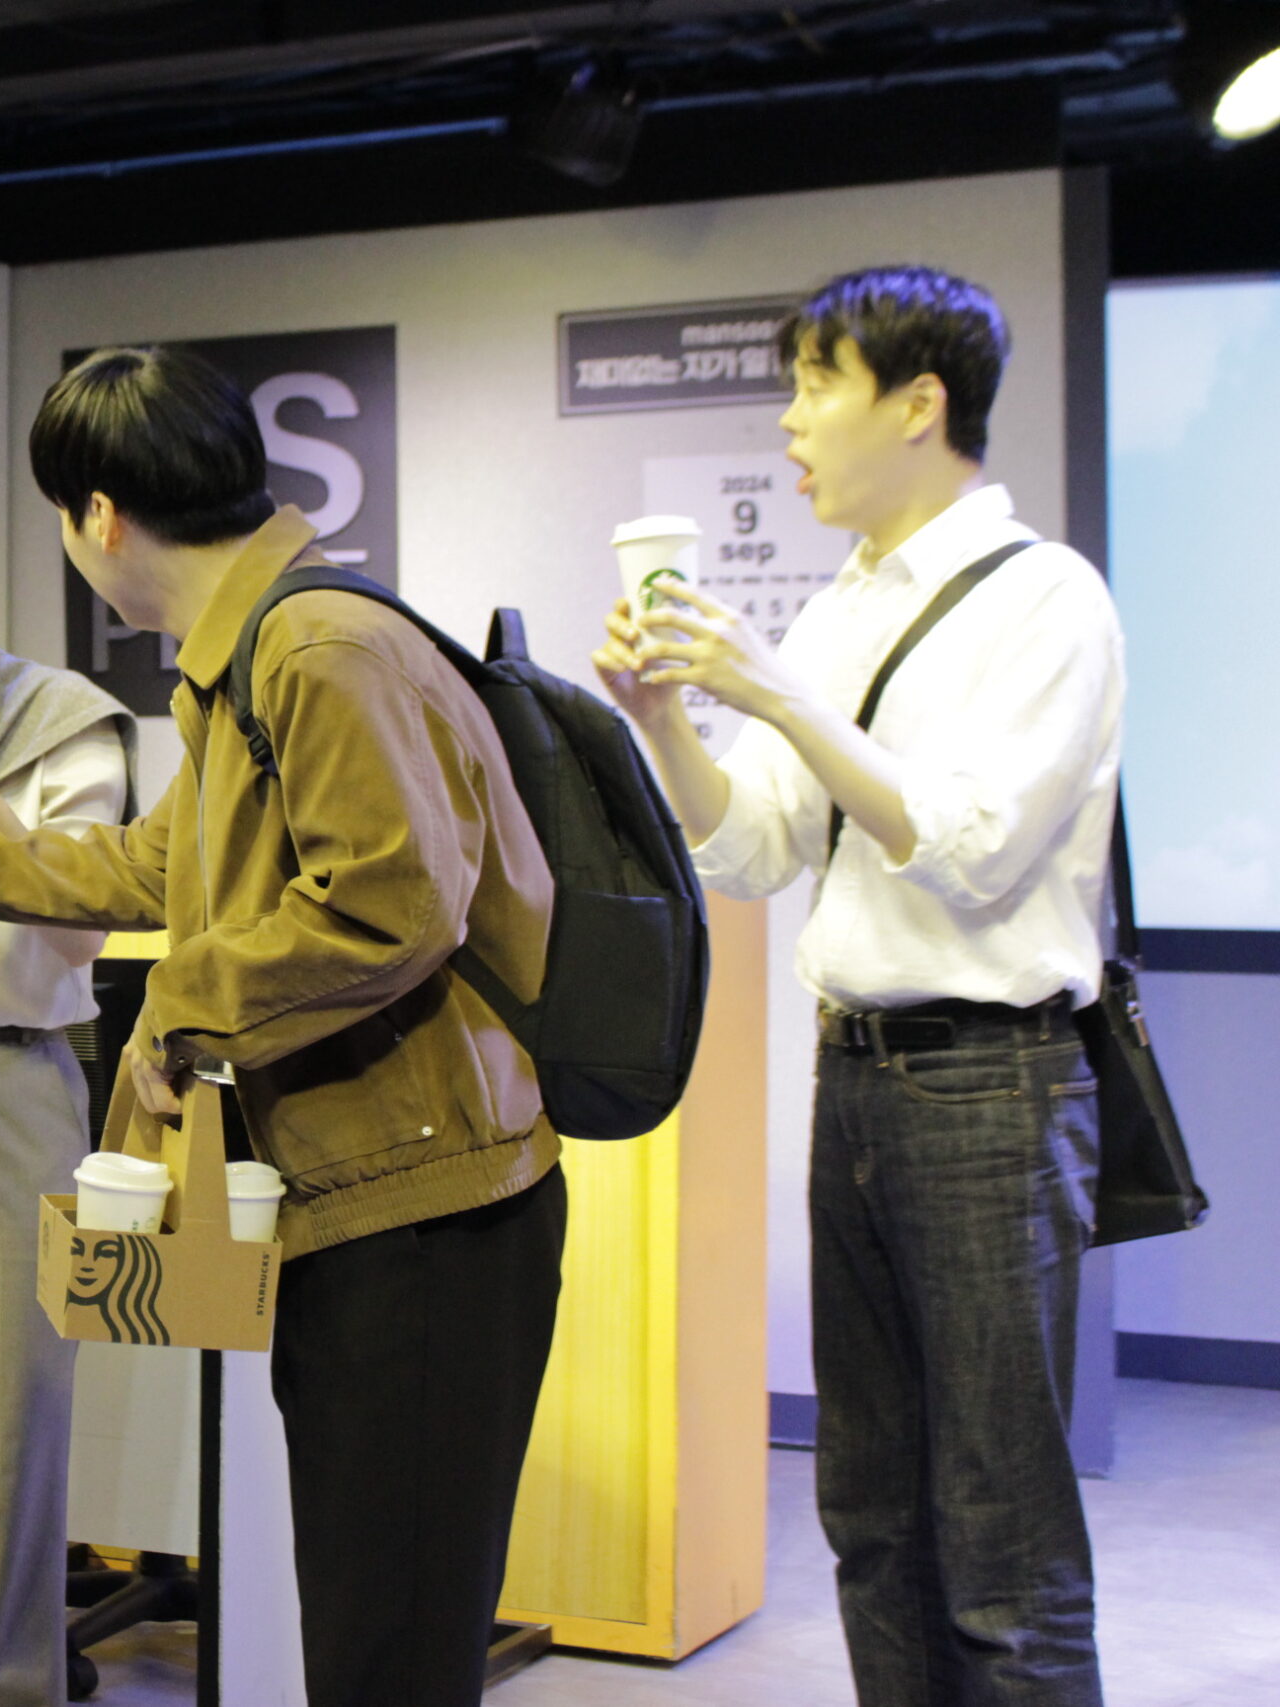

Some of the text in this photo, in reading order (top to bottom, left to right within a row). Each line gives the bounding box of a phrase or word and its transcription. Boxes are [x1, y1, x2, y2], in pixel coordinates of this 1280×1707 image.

[720, 475, 772, 494] 2024
[733, 499, 760, 536] 9
[719, 542, 776, 566] sep
[742, 601, 756, 617] 4
[256, 1253, 270, 1316] STARBUCKS
